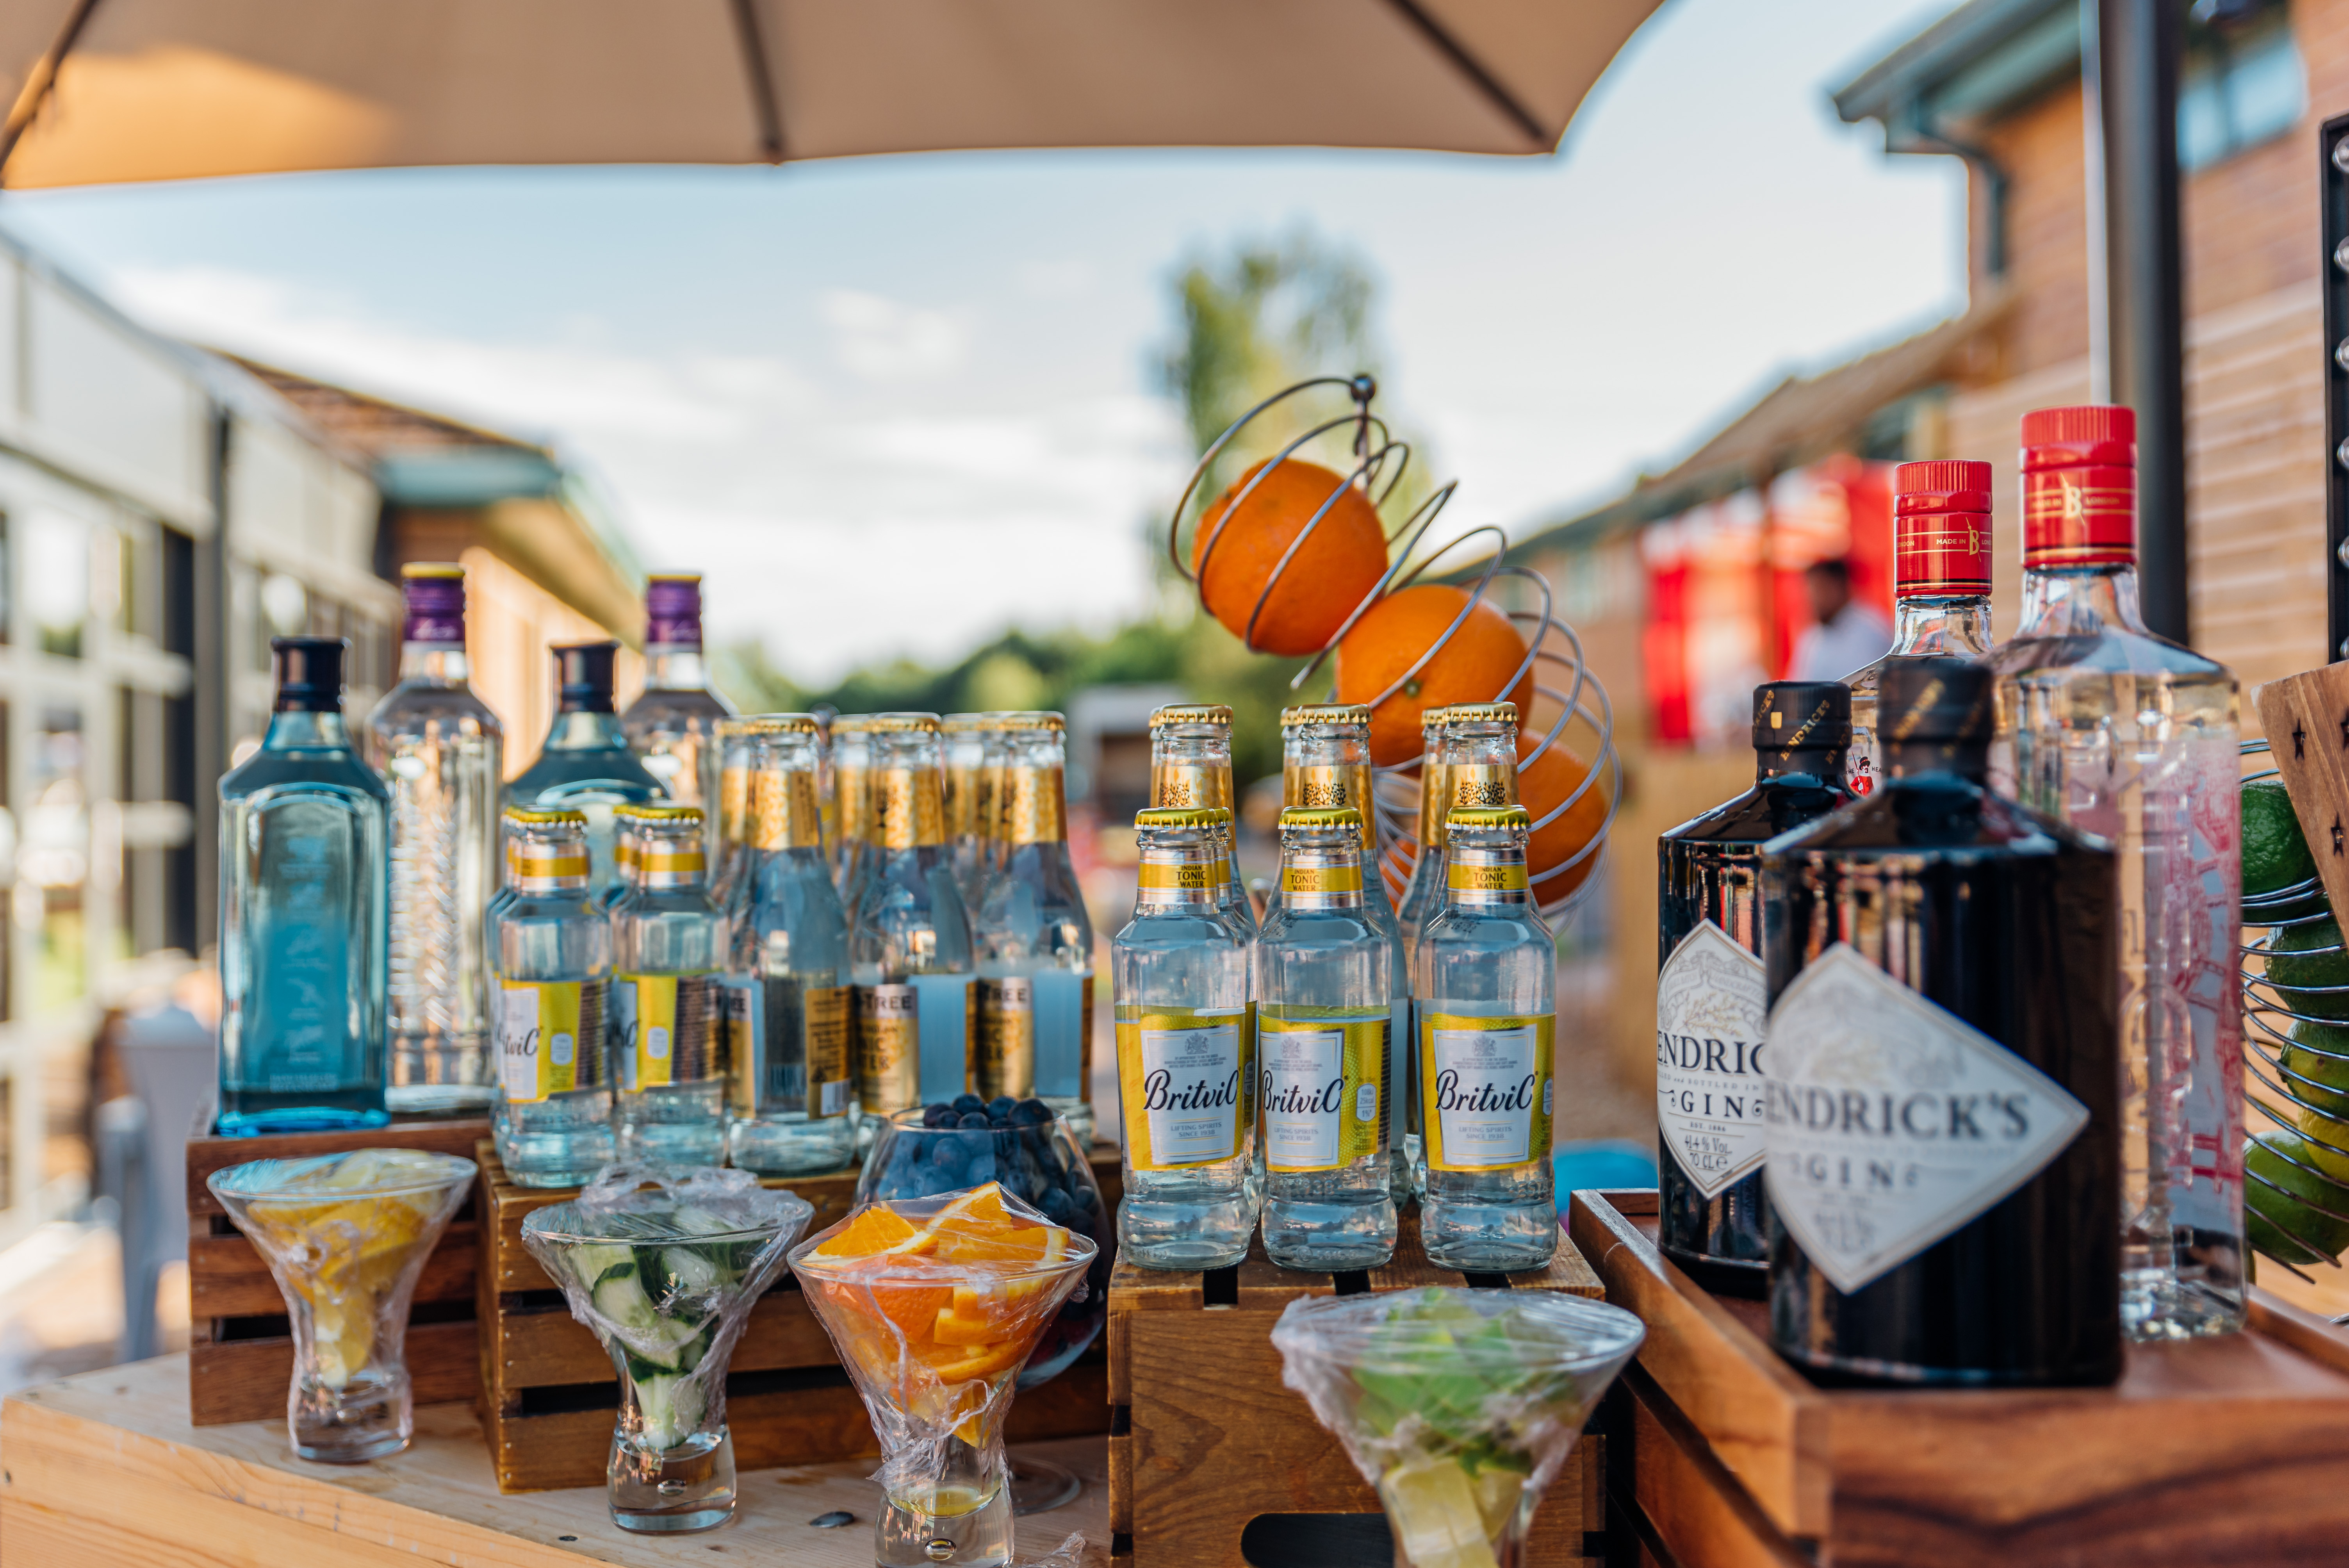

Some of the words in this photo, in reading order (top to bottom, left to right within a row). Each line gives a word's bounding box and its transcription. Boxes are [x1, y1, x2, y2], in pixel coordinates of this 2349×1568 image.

[2085, 496, 2120, 505] LONDON
[1176, 871, 1206, 880] TONIC
[1290, 875, 1319, 884] TONIC
[1474, 872, 1507, 882] TONIC
[1658, 1030, 1766, 1076] ENDRIC
[1688, 1078, 1738, 1089] BOTTLED
[1681, 1090, 1745, 1118] GIN
[1765, 1081, 2029, 1140] ENDRICK'S
[1690, 1152, 1700, 1166] 70
[1805, 1151, 1894, 1188] GIN
